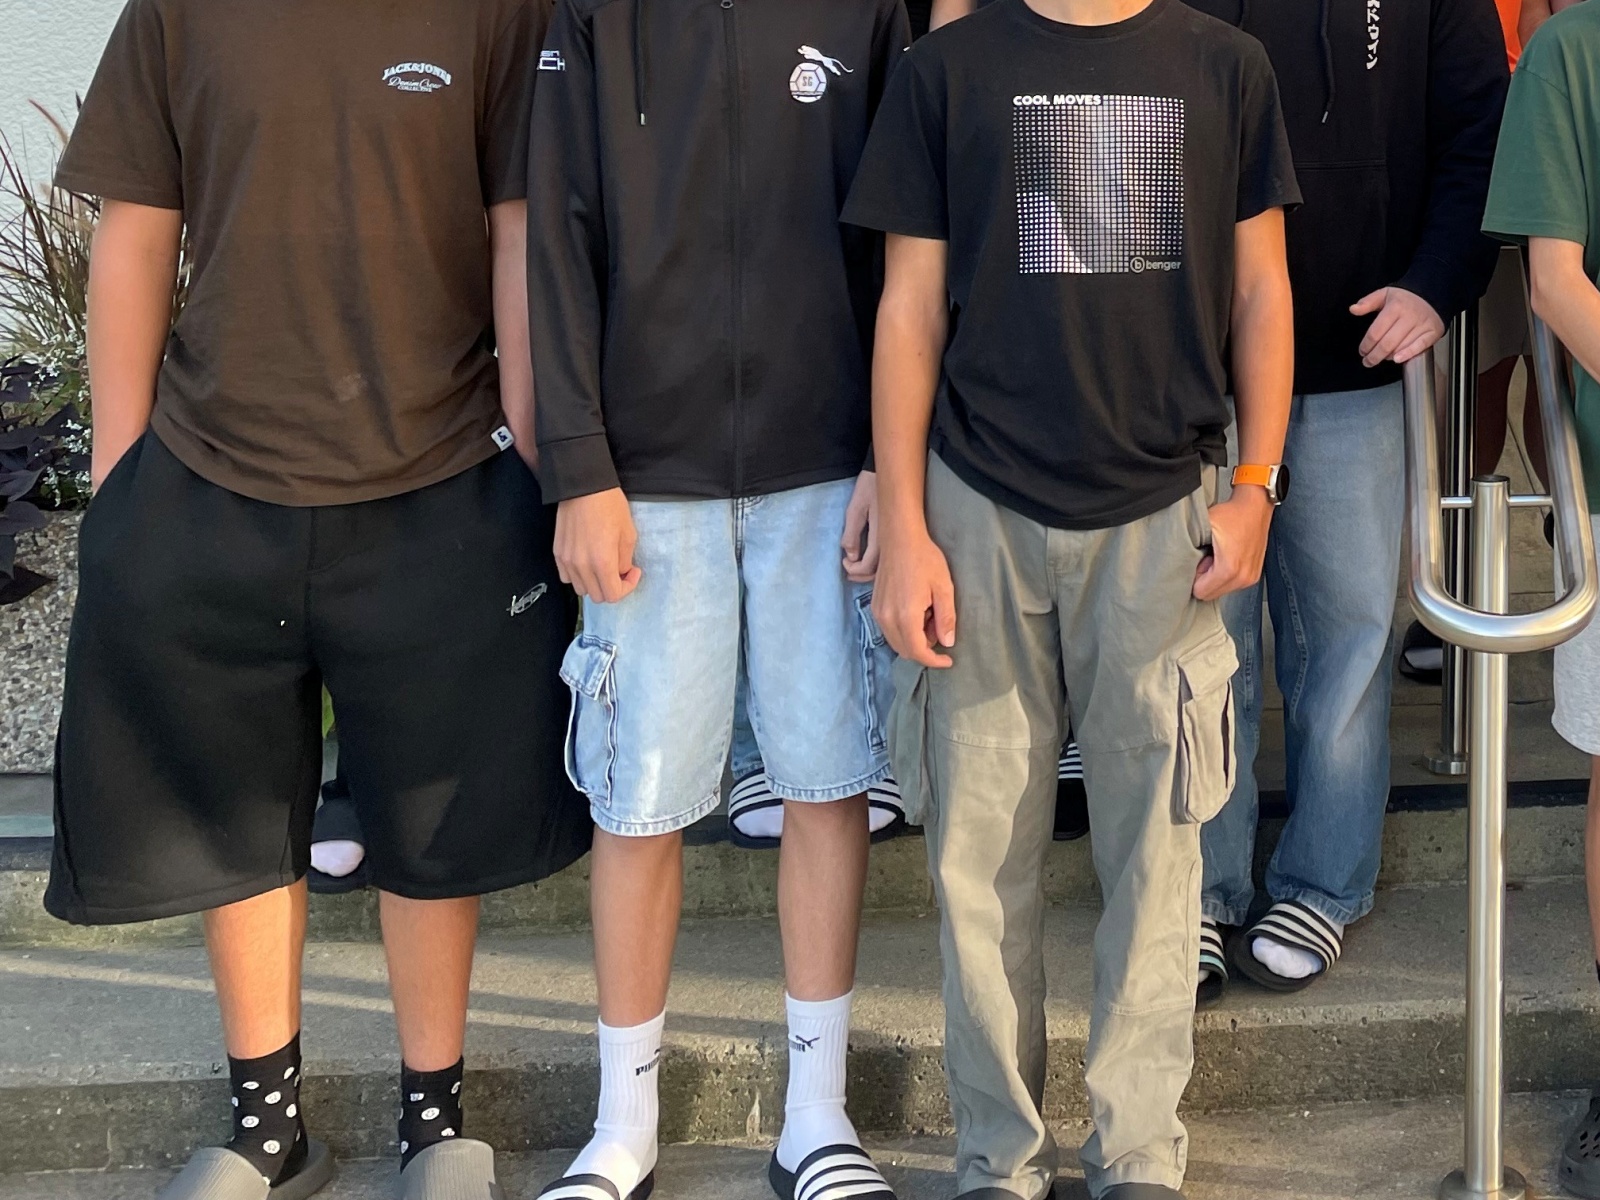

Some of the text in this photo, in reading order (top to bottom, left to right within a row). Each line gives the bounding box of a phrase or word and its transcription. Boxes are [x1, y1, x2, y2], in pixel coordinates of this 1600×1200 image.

[1013, 94, 1101, 106] COOL MOVES
[1146, 259, 1181, 272] benger
